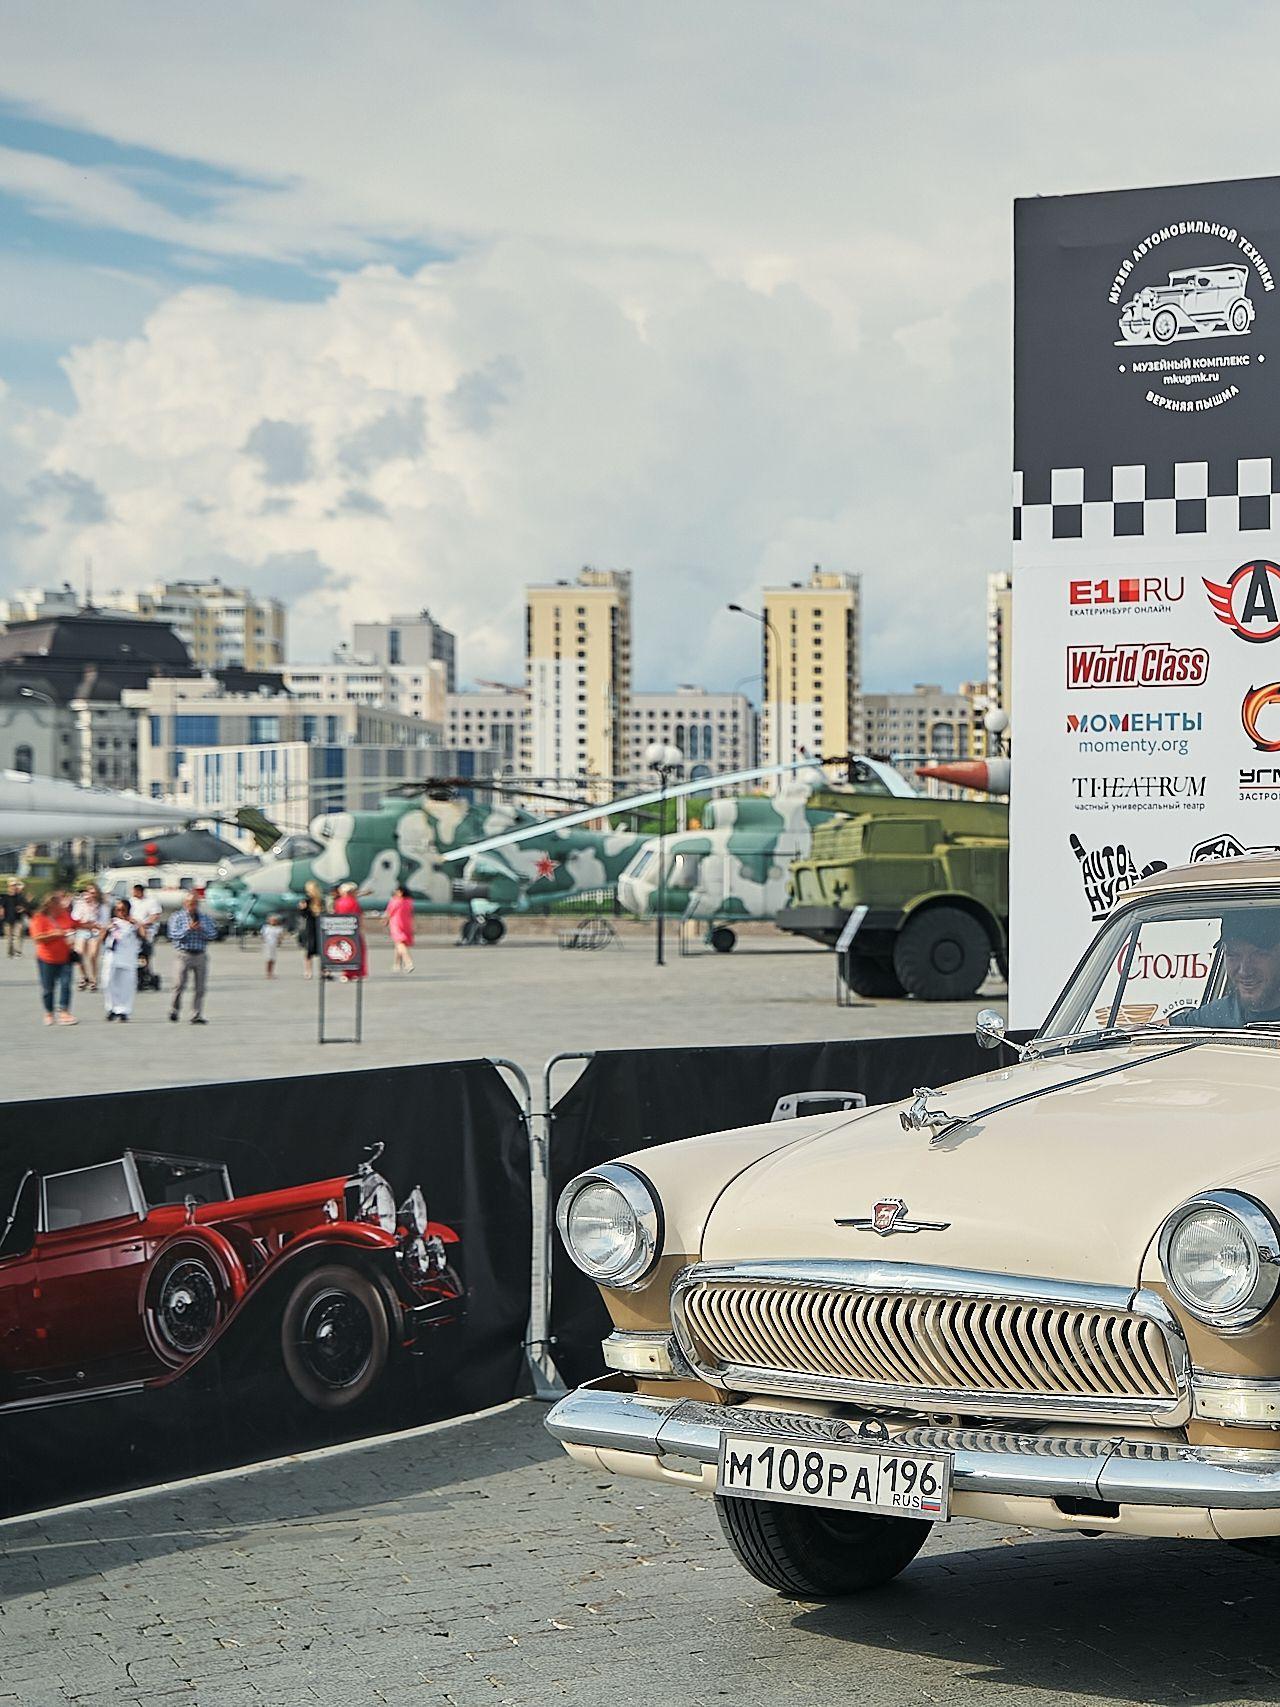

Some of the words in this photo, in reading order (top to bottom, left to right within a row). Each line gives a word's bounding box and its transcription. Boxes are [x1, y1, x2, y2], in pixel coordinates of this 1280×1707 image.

[1108, 259, 1135, 304] МУЗЕЙ
[1132, 221, 1238, 262] АВТОМОБИЛЬНОЙ
[1238, 236, 1275, 292] ТЕХНИКИ
[1132, 357, 1192, 373] МУЗЕЙНЫЙ
[1192, 354, 1250, 369] КОМПЛЕКС
[1163, 372, 1219, 385] mkugmk.ru
[1145, 390, 1194, 412] ВЕРХНЯЯ
[1195, 385, 1239, 411] ПЫШМА
[1069, 606, 1132, 617] ЕКАТЕРИНБУРГ
[1134, 604, 1172, 614] ОНЛАЙН
[1072, 650, 1139, 684] World
[1141, 649, 1204, 682] Class
[1066, 712, 1202, 733] МОМЕНТЫ
[1079, 738, 1189, 756] momenty.org
[1074, 802, 1109, 812] частный
[1112, 802, 1180, 812] универсальный
[1183, 802, 1206, 812] театр
[1083, 845, 1127, 884] AUTO
[730, 1446, 872, 1502] М108РА
[882, 1458, 938, 1496] 196
[892, 1494, 920, 1508] RUS
